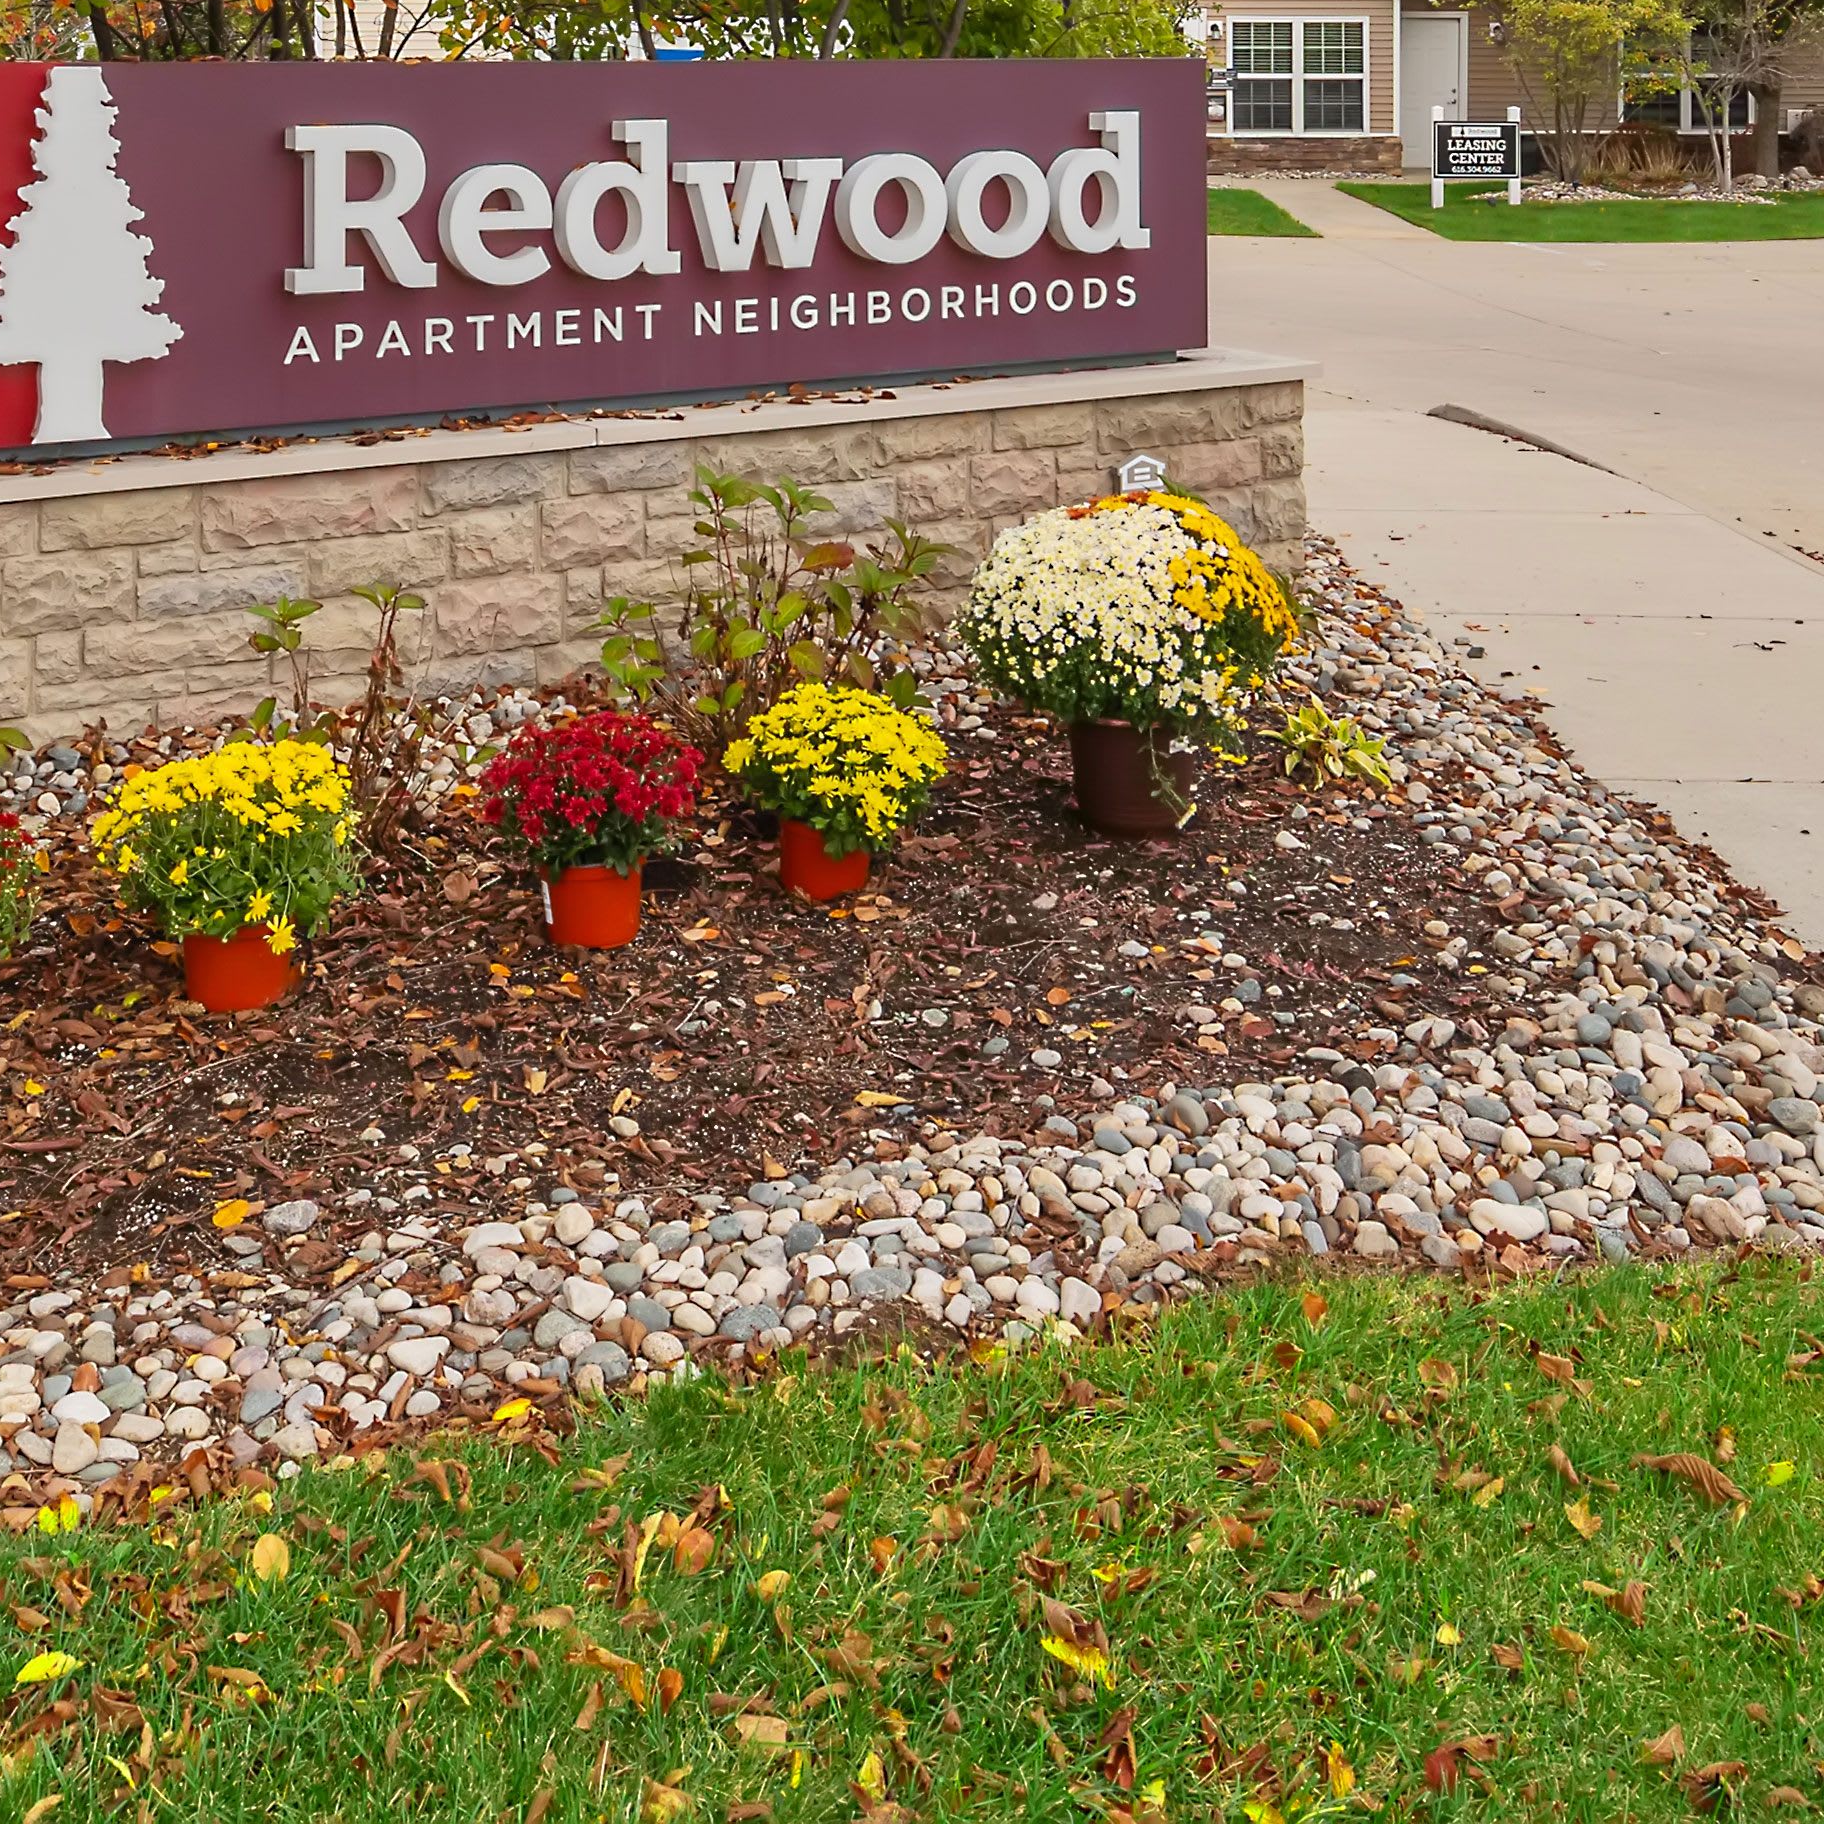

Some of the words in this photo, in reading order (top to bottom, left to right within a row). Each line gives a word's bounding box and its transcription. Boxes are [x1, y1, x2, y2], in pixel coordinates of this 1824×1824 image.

[1447, 139, 1507, 151] LEASING
[1449, 152, 1505, 164] CENTER
[283, 109, 1151, 295] Redwood
[283, 302, 663, 366] APARTMENT
[693, 273, 1140, 337] NEIGHBORHOODS
